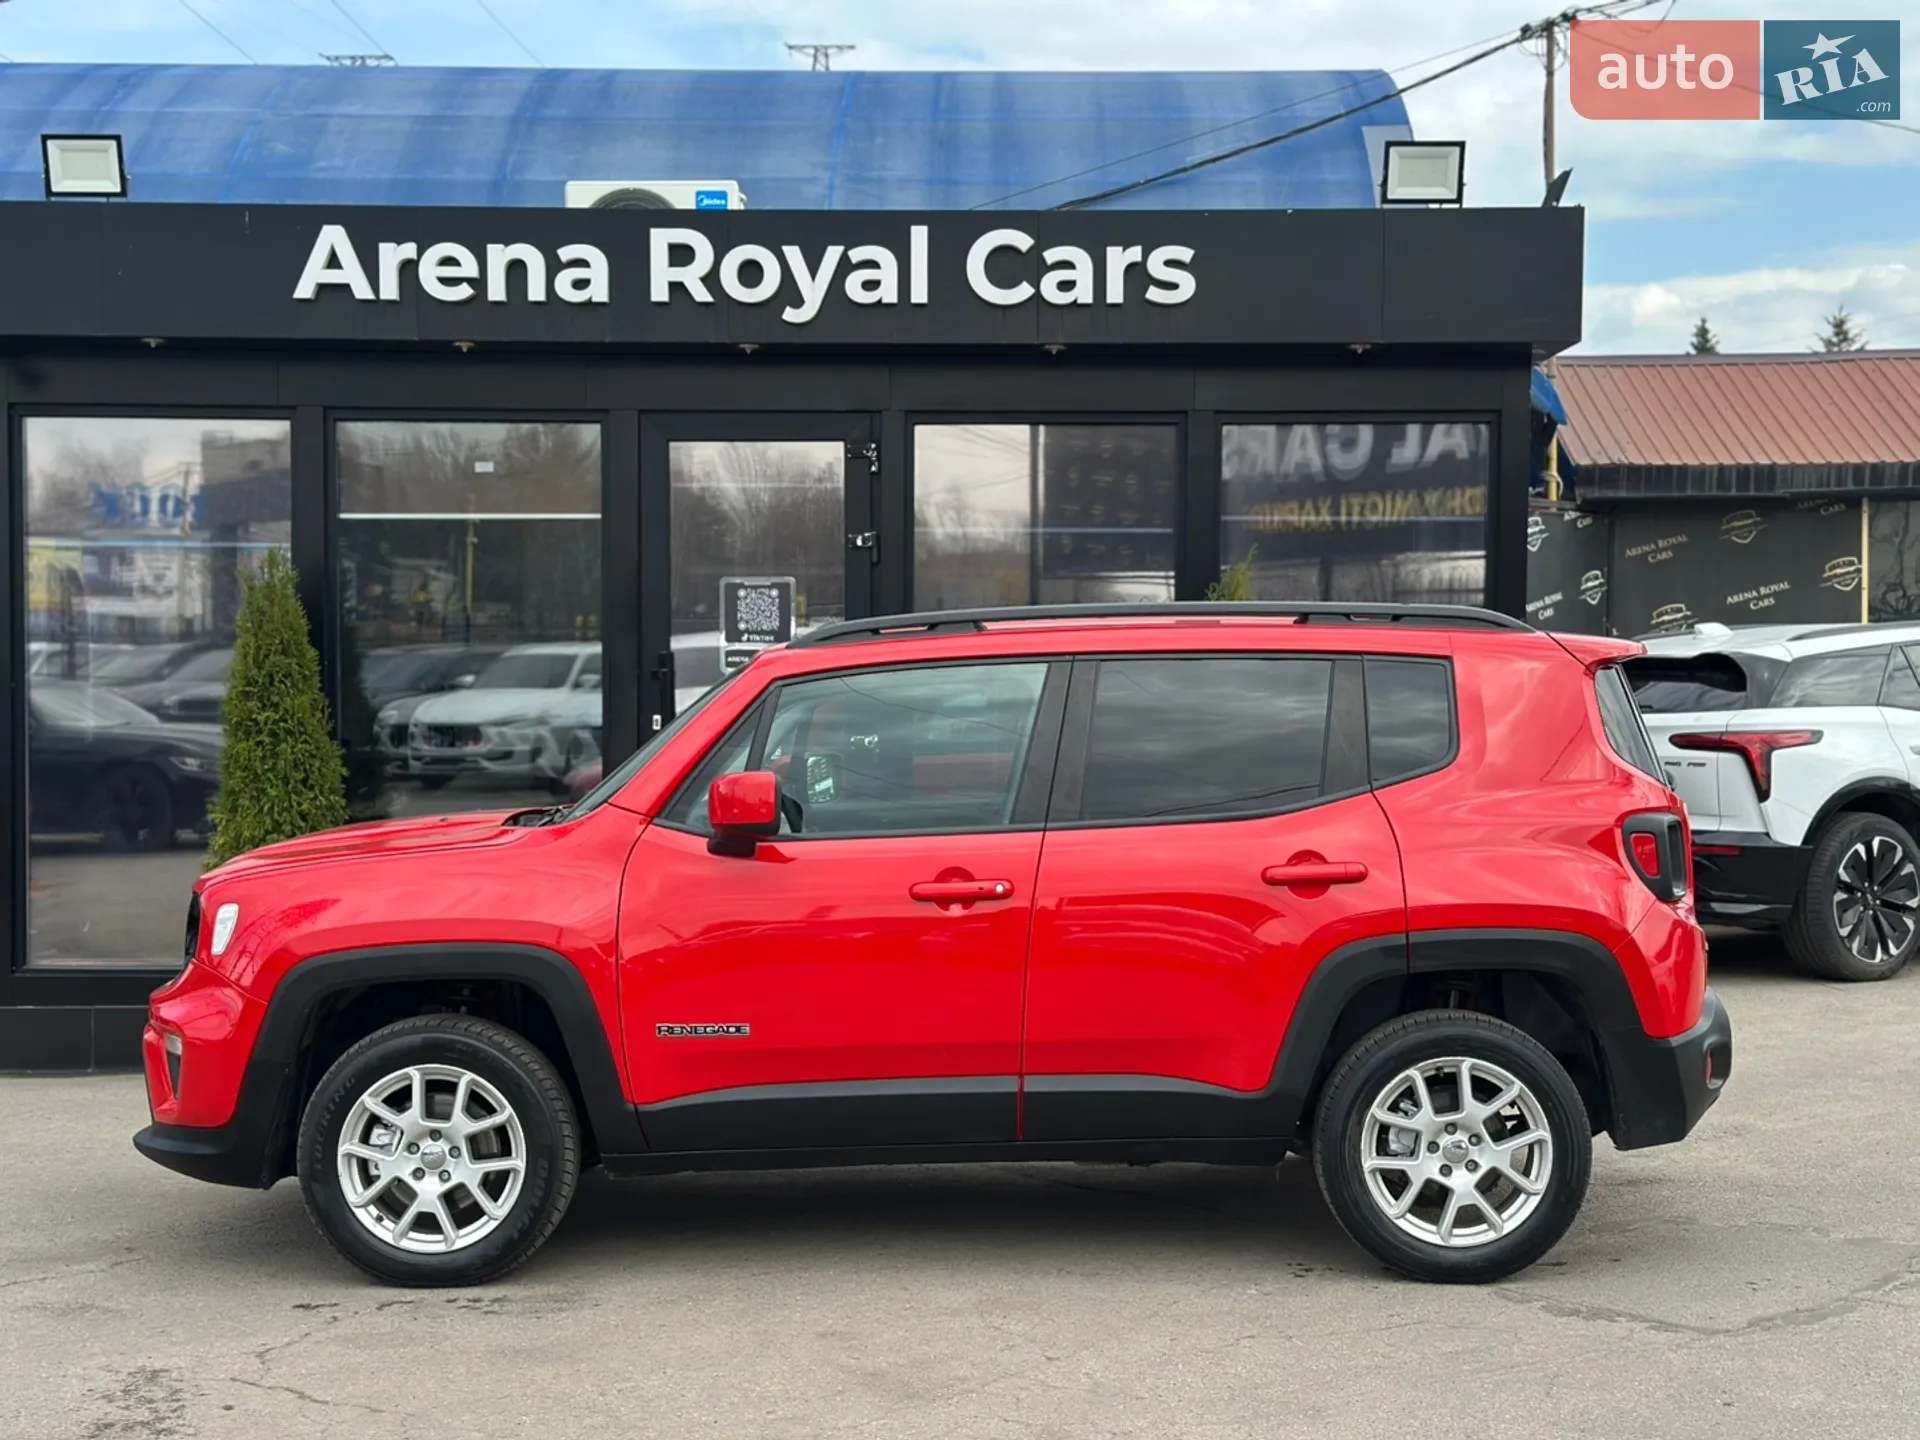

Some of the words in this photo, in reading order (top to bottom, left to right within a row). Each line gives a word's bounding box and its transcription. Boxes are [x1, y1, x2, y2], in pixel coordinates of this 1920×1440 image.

[292, 224, 610, 303] Arena
[649, 225, 929, 324] Royal
[966, 228, 1197, 306] Cars
[656, 1023, 750, 1037] RENEGADE
